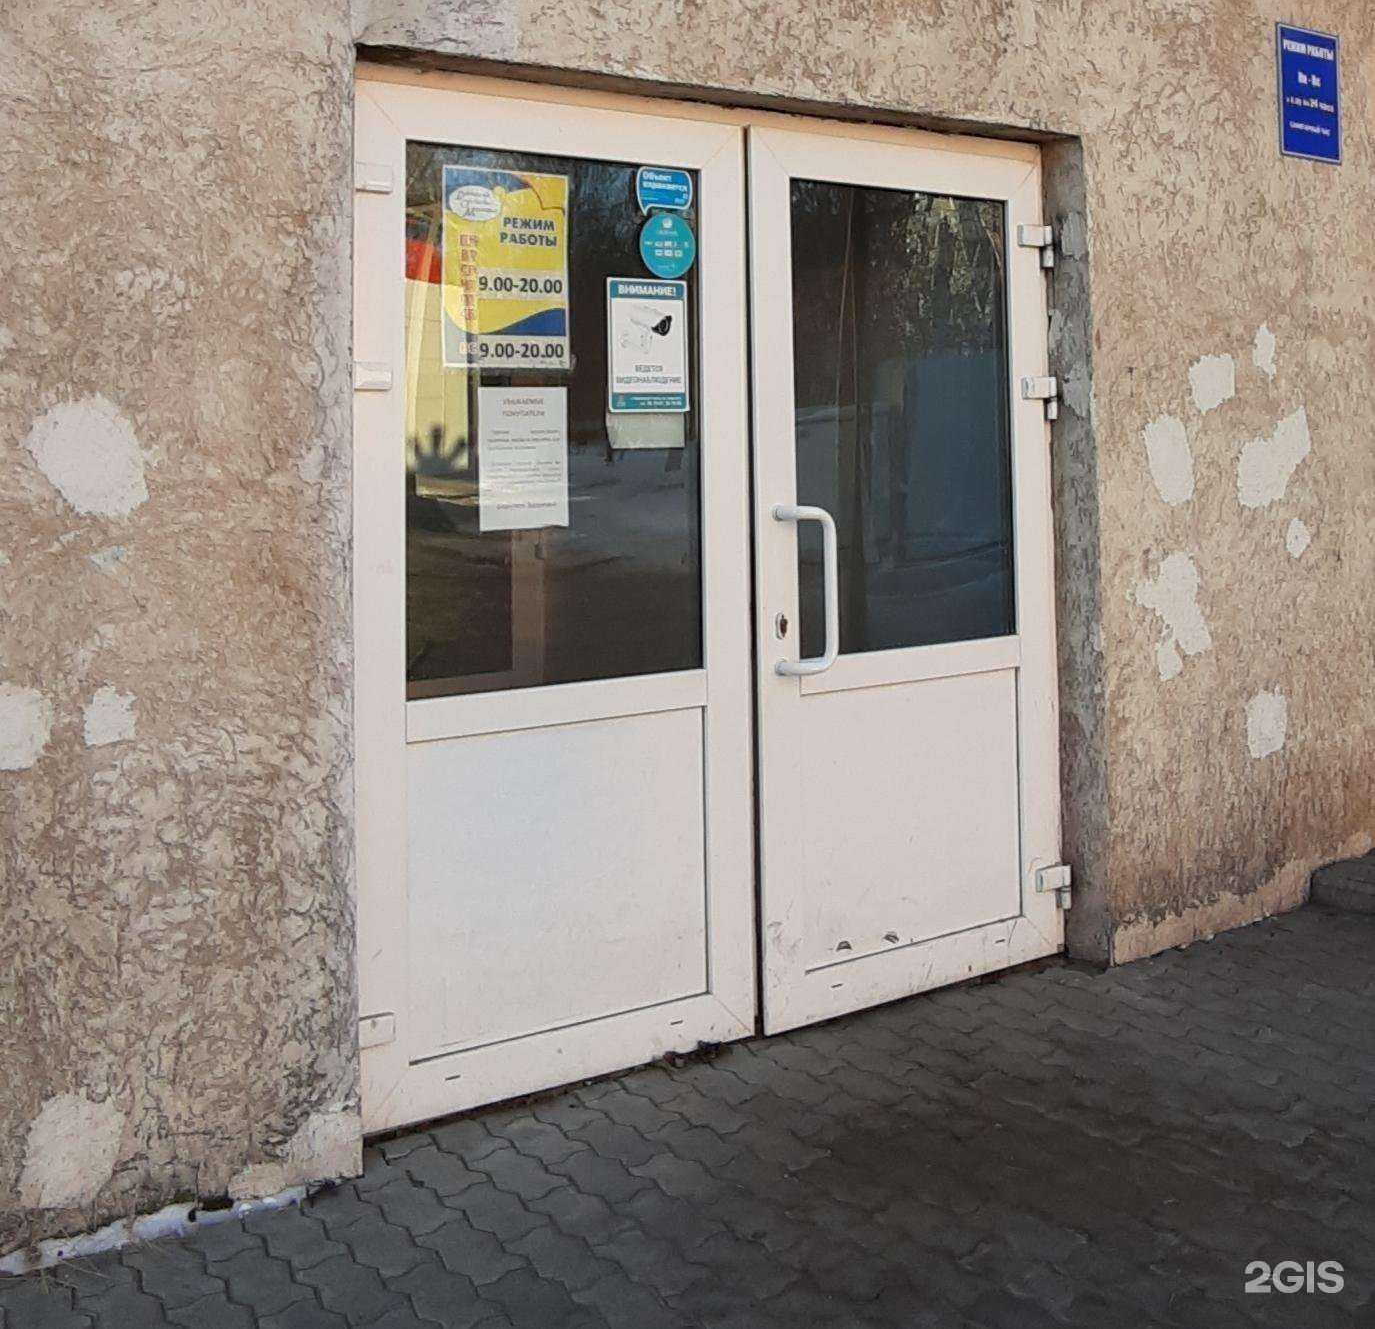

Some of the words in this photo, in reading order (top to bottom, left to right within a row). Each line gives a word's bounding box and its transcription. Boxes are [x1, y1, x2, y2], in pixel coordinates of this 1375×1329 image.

[503, 217, 555, 231] РЕЖИМ
[500, 232, 557, 247] РАБОТЫ
[479, 276, 563, 294] 9.00-20.00
[618, 284, 677, 296] ВНИМАНИЕ!
[480, 342, 564, 358] 9.00-20.00
